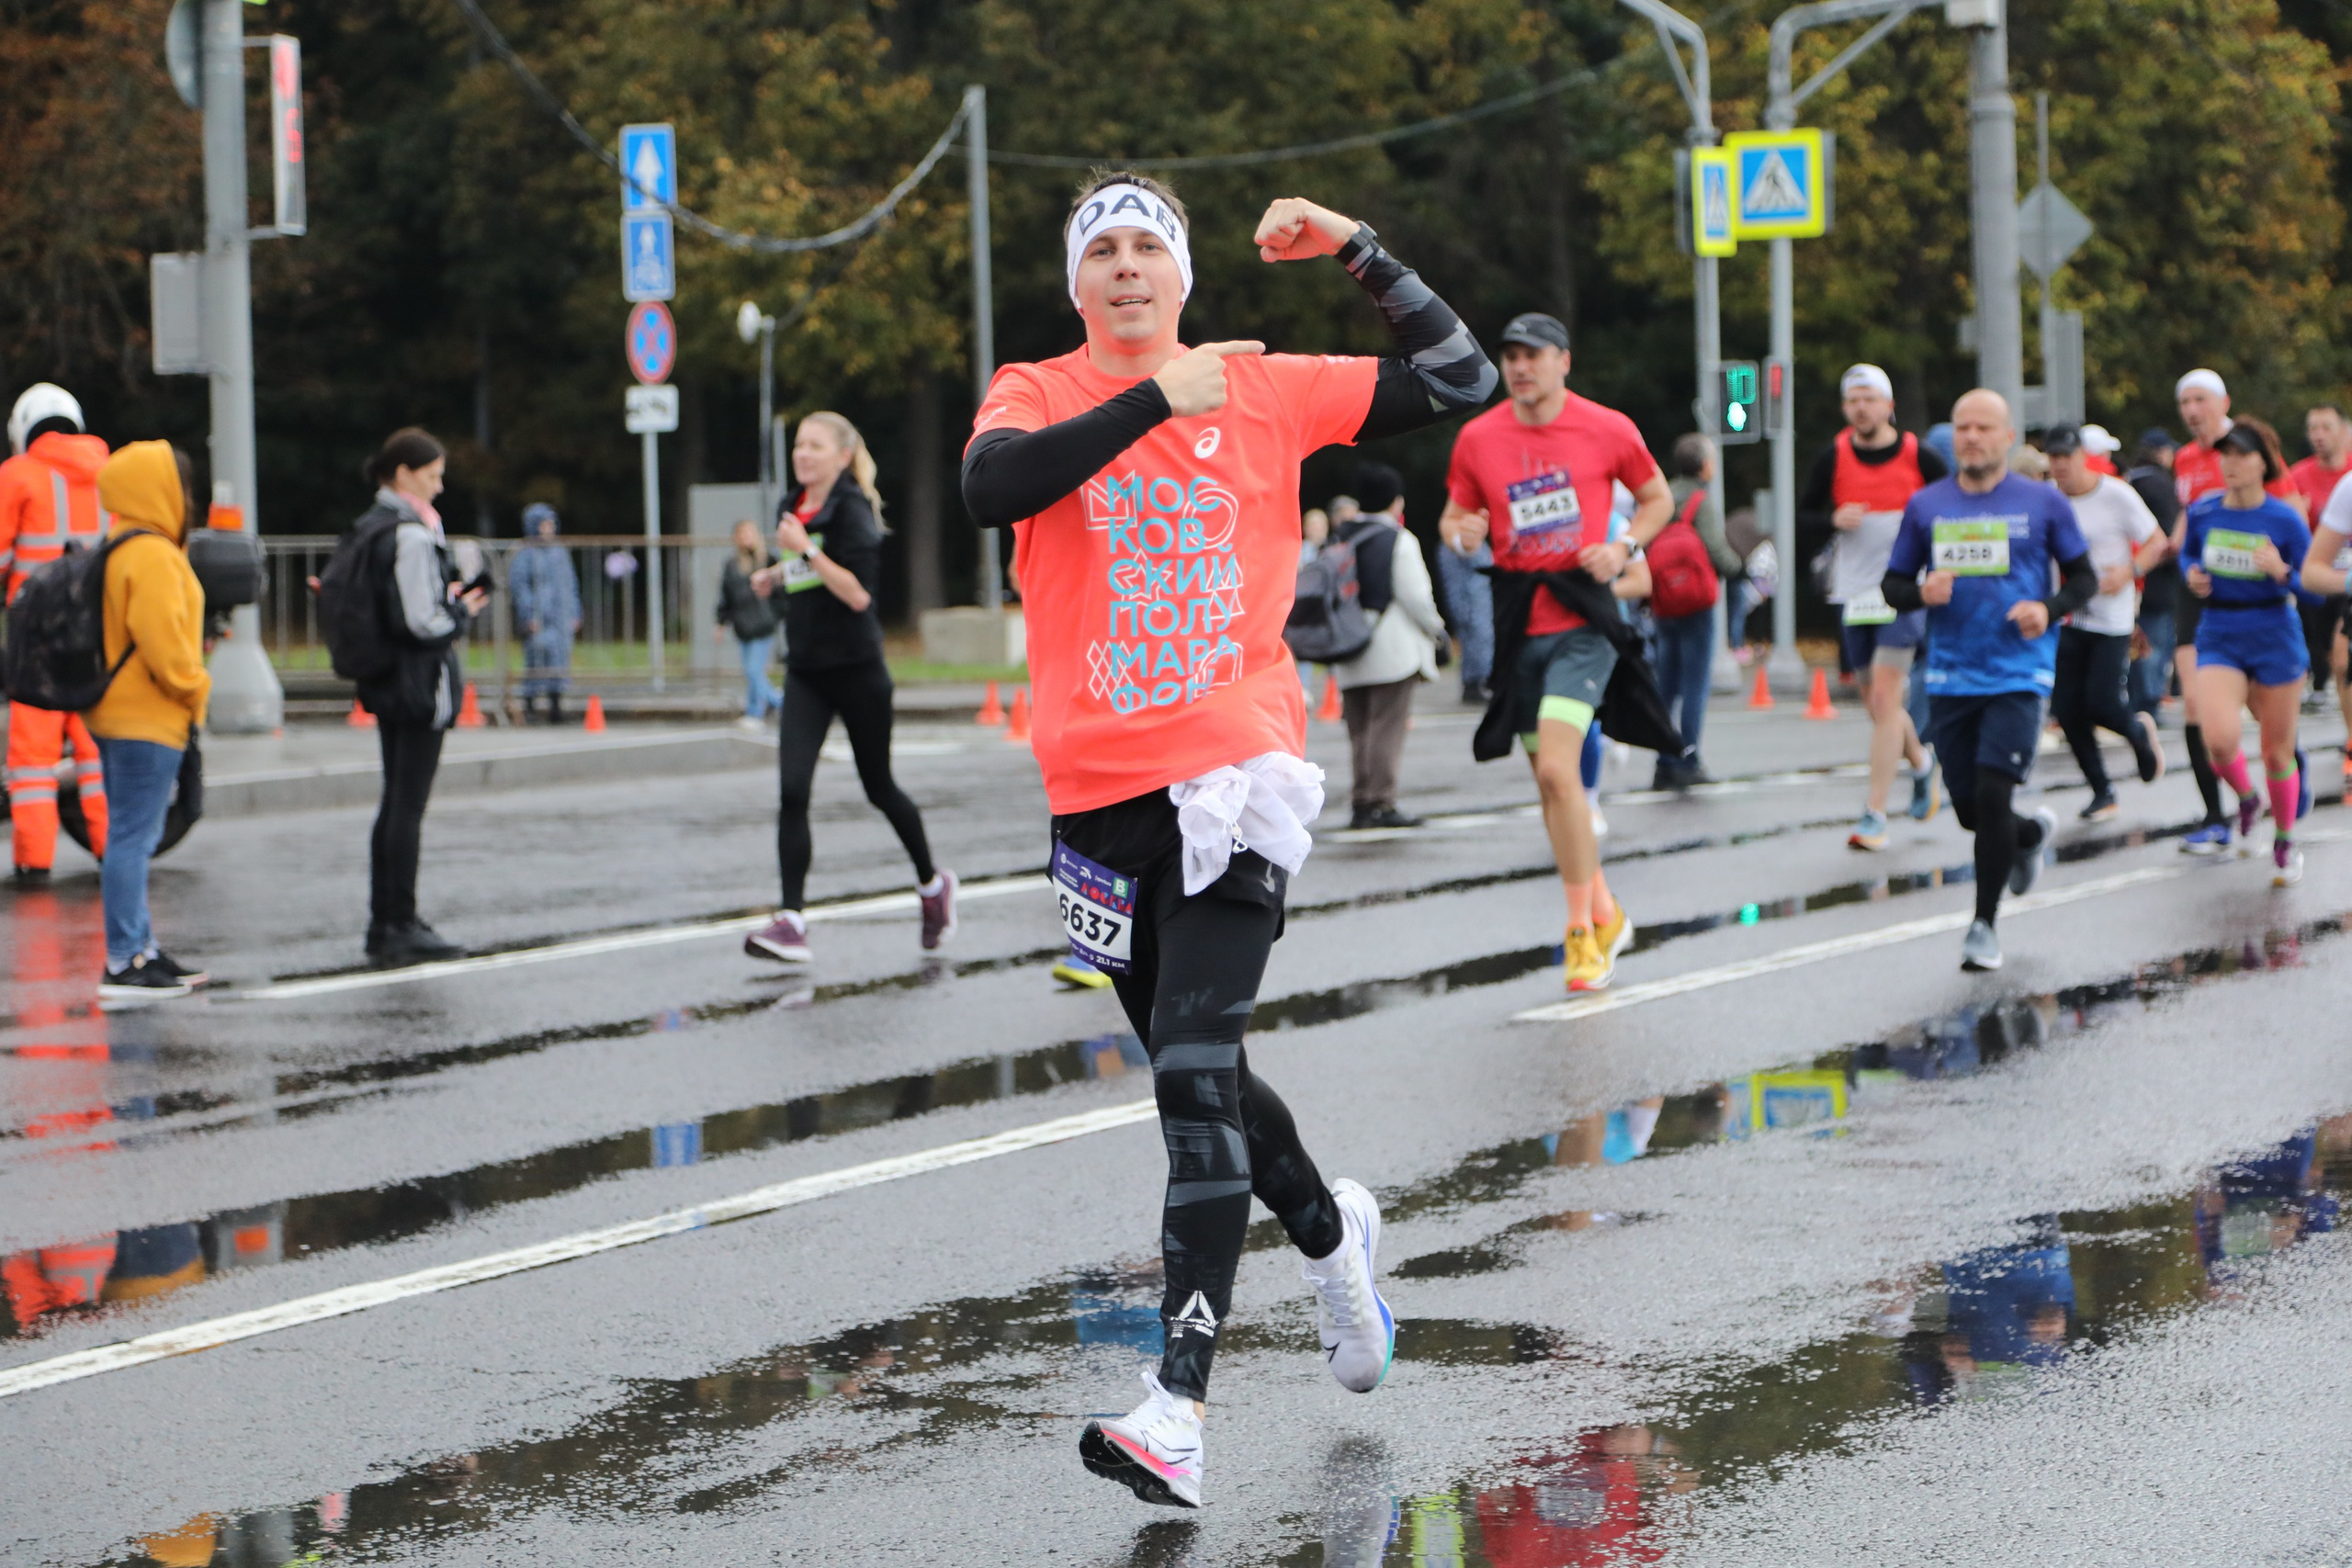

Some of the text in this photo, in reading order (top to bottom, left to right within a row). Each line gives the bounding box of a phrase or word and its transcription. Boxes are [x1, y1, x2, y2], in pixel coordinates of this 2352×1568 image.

[1106, 476, 1222, 513] МОС
[1108, 517, 1206, 554] КОВ
[1108, 543, 1237, 595] СКИЙ
[1109, 596, 1237, 637] ПОЛУ
[1111, 635, 1238, 678] МАРА
[1112, 669, 1216, 715] ФОН
[1059, 893, 1122, 947] 6637
